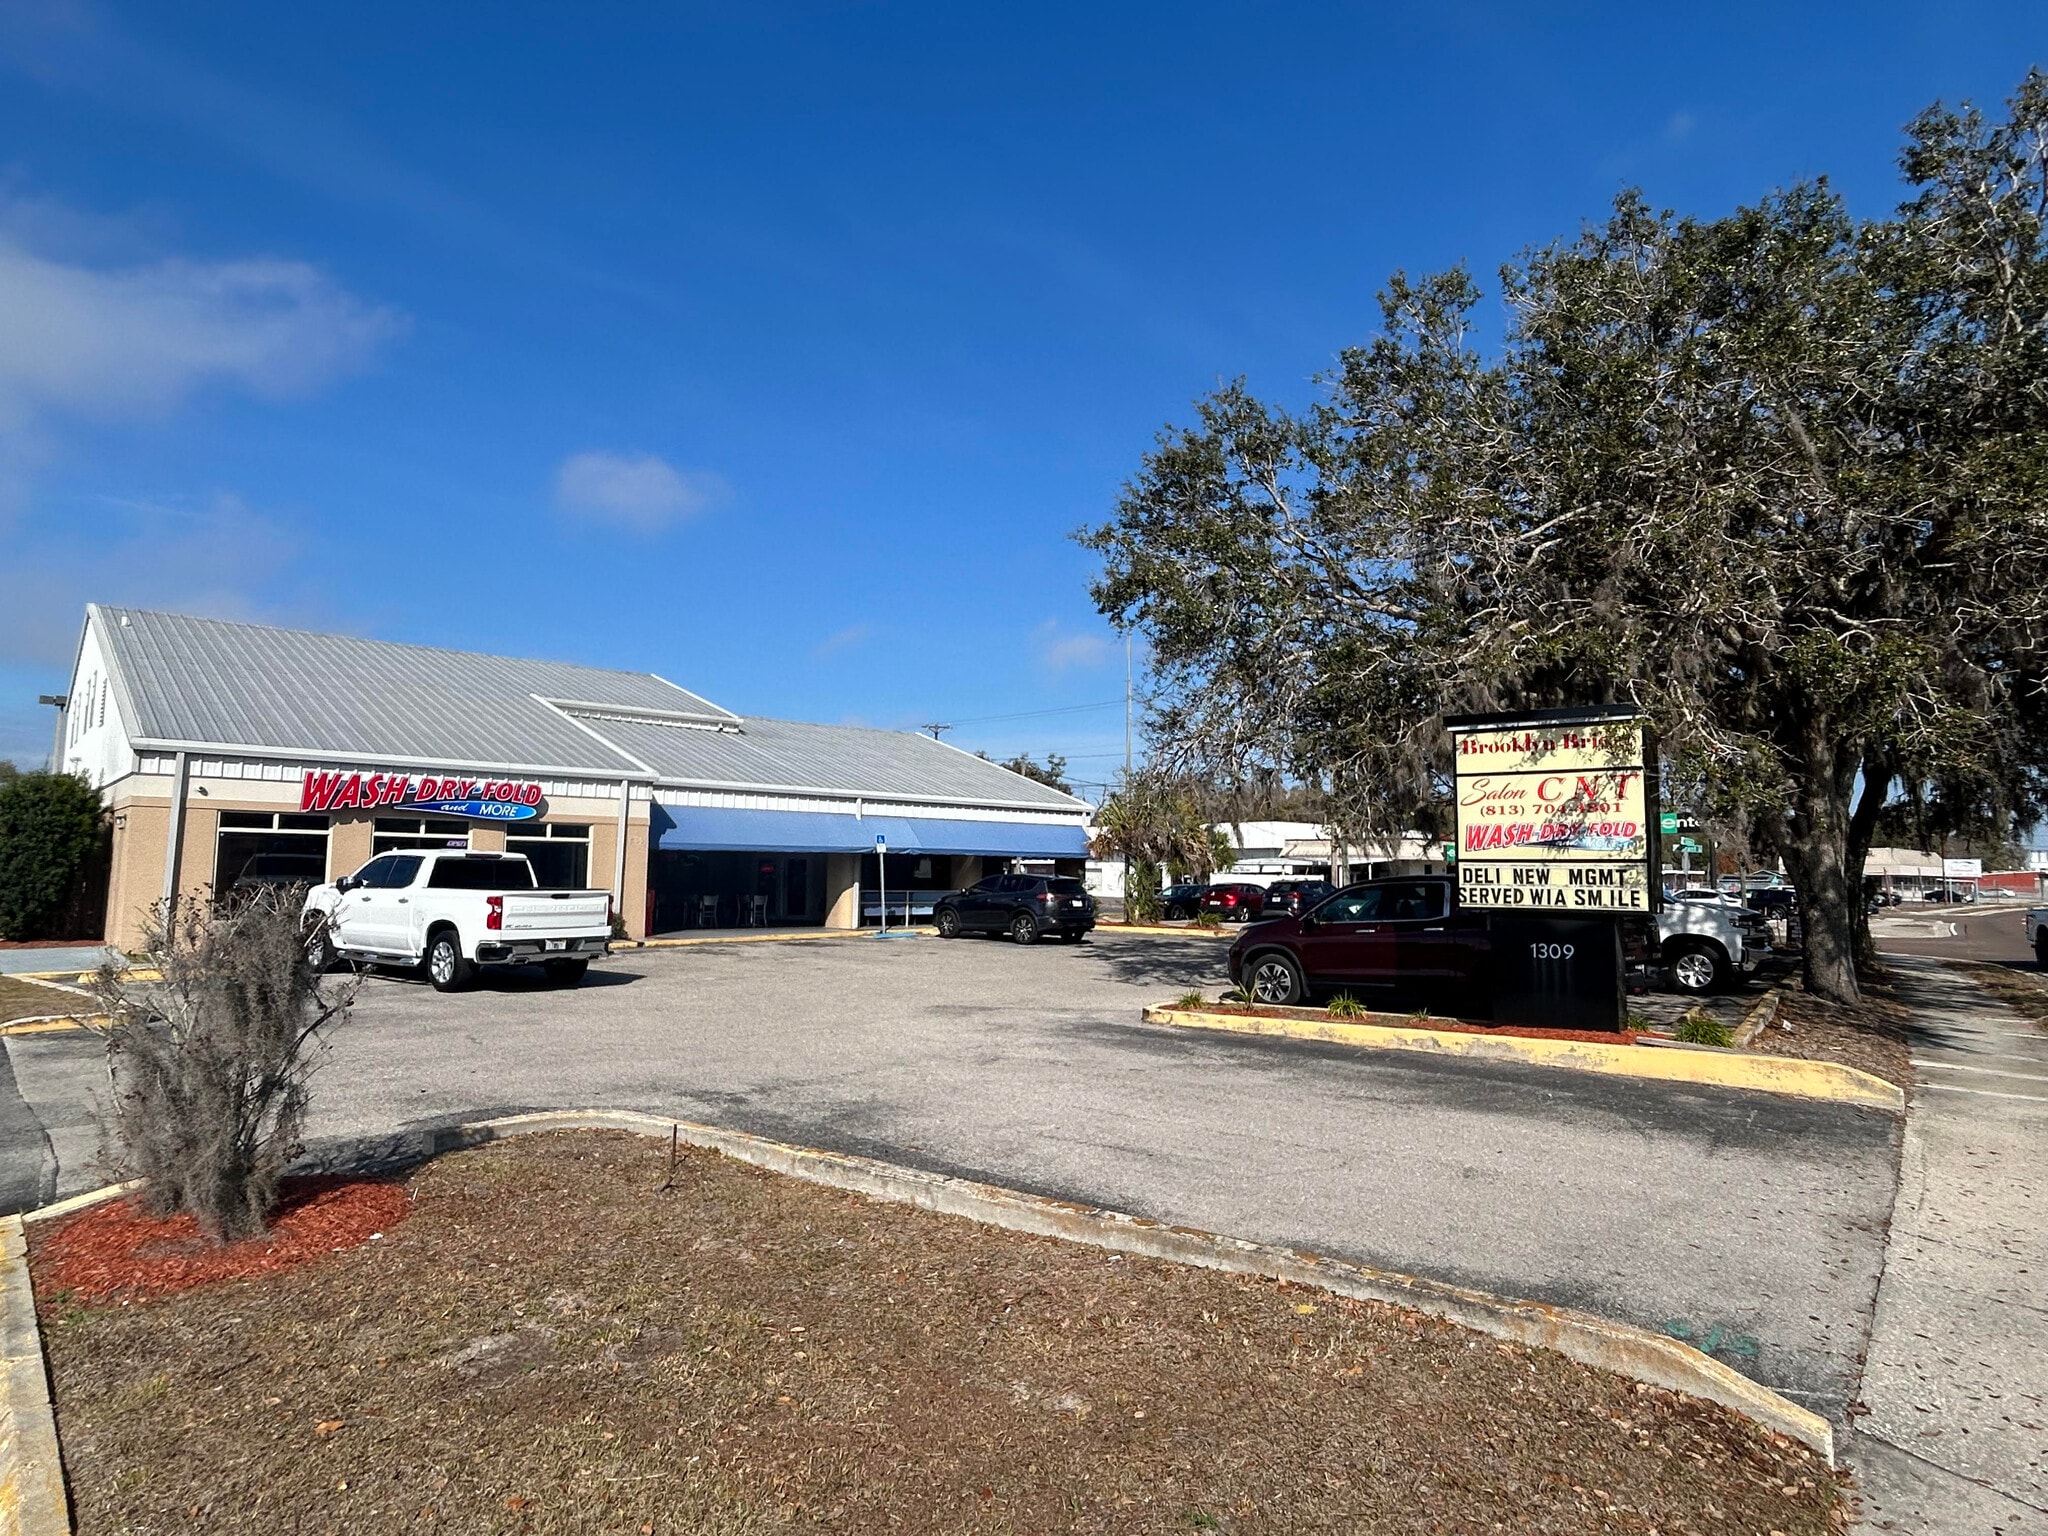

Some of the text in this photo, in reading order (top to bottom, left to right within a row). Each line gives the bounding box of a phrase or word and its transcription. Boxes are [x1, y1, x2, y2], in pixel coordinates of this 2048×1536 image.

[1462, 733, 1556, 755] Brooklyn
[301, 770, 542, 812] WASH DRY FOLD
[1460, 777, 1528, 806] Salon
[440, 803, 519, 817] and MORE
[1480, 804, 1525, 817] (813)
[1466, 821, 1638, 851] WASH DRY FOLD
[1463, 868, 1627, 886] DELI NEW MGMT
[1459, 887, 1524, 904] SERVED
[1574, 888, 1640, 907] SMILE
[1530, 942, 1575, 960] 1309
